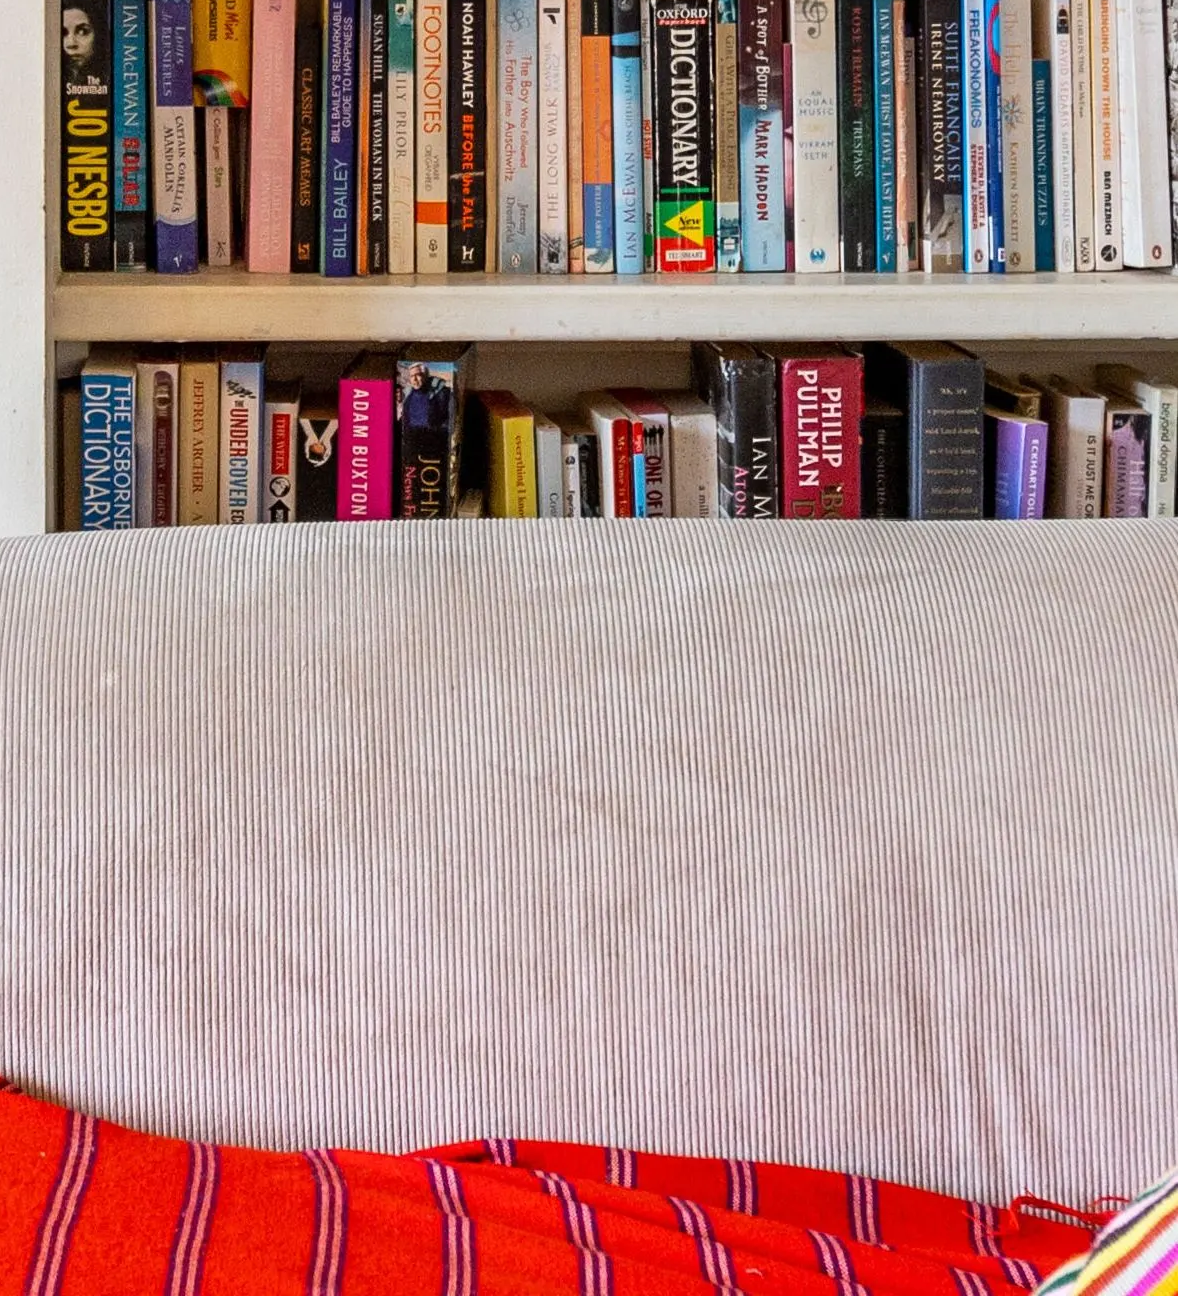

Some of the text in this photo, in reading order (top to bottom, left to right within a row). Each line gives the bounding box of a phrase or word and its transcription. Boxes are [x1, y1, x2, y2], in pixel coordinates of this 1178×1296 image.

[223, 12, 239, 42] Mini
[462, 2, 474, 108] NOAH HAWLEY
[656, 8, 708, 20] OXFORD
[944, 21, 959, 73] SUITE
[68, 99, 108, 136] JO
[331, 1, 342, 143] BILL BAILEY'S REMARKABLE
[342, 16, 353, 127] GUIDE TO HAPPINESS
[372, 14, 384, 221] SUSAN HILL THE WOMAN IN BLACK
[423, 5, 442, 134] FOOTNOTES
[669, 27, 699, 187] DICTIONARY
[799, 108, 835, 117] MUSIC
[968, 10, 982, 129] FREAKONOMICS
[1101, 57, 1112, 92] DOWN
[1102, 97, 1112, 118] THE
[299, 67, 313, 207] CLASSIC ART MEMES
[462, 114, 474, 232] BEFORE the FALL
[546, 97, 559, 221] THE LONG WALK
[754, 119, 772, 221] MARK HADDON
[853, 119, 863, 177] TRESPASS
[1035, 79, 1048, 226] BRAIN TRAINING PUZZLES
[1102, 122, 1112, 161] HOUSE
[333, 158, 348, 259] BILL BAILEY
[113, 382, 131, 423] THE
[191, 378, 205, 494] JEFFREY ARCHER
[350, 388, 370, 516] ADAM BUXTON
[797, 369, 820, 487] PULLMAN
[821, 387, 843, 468] PHILIP
[83, 383, 112, 531] DICTIONARY
[228, 408, 249, 507] UNDERCOVER
[645, 456, 663, 508] ONE OF
[752, 436, 772, 481] IAN
[1158, 445, 1170, 483] dogma
